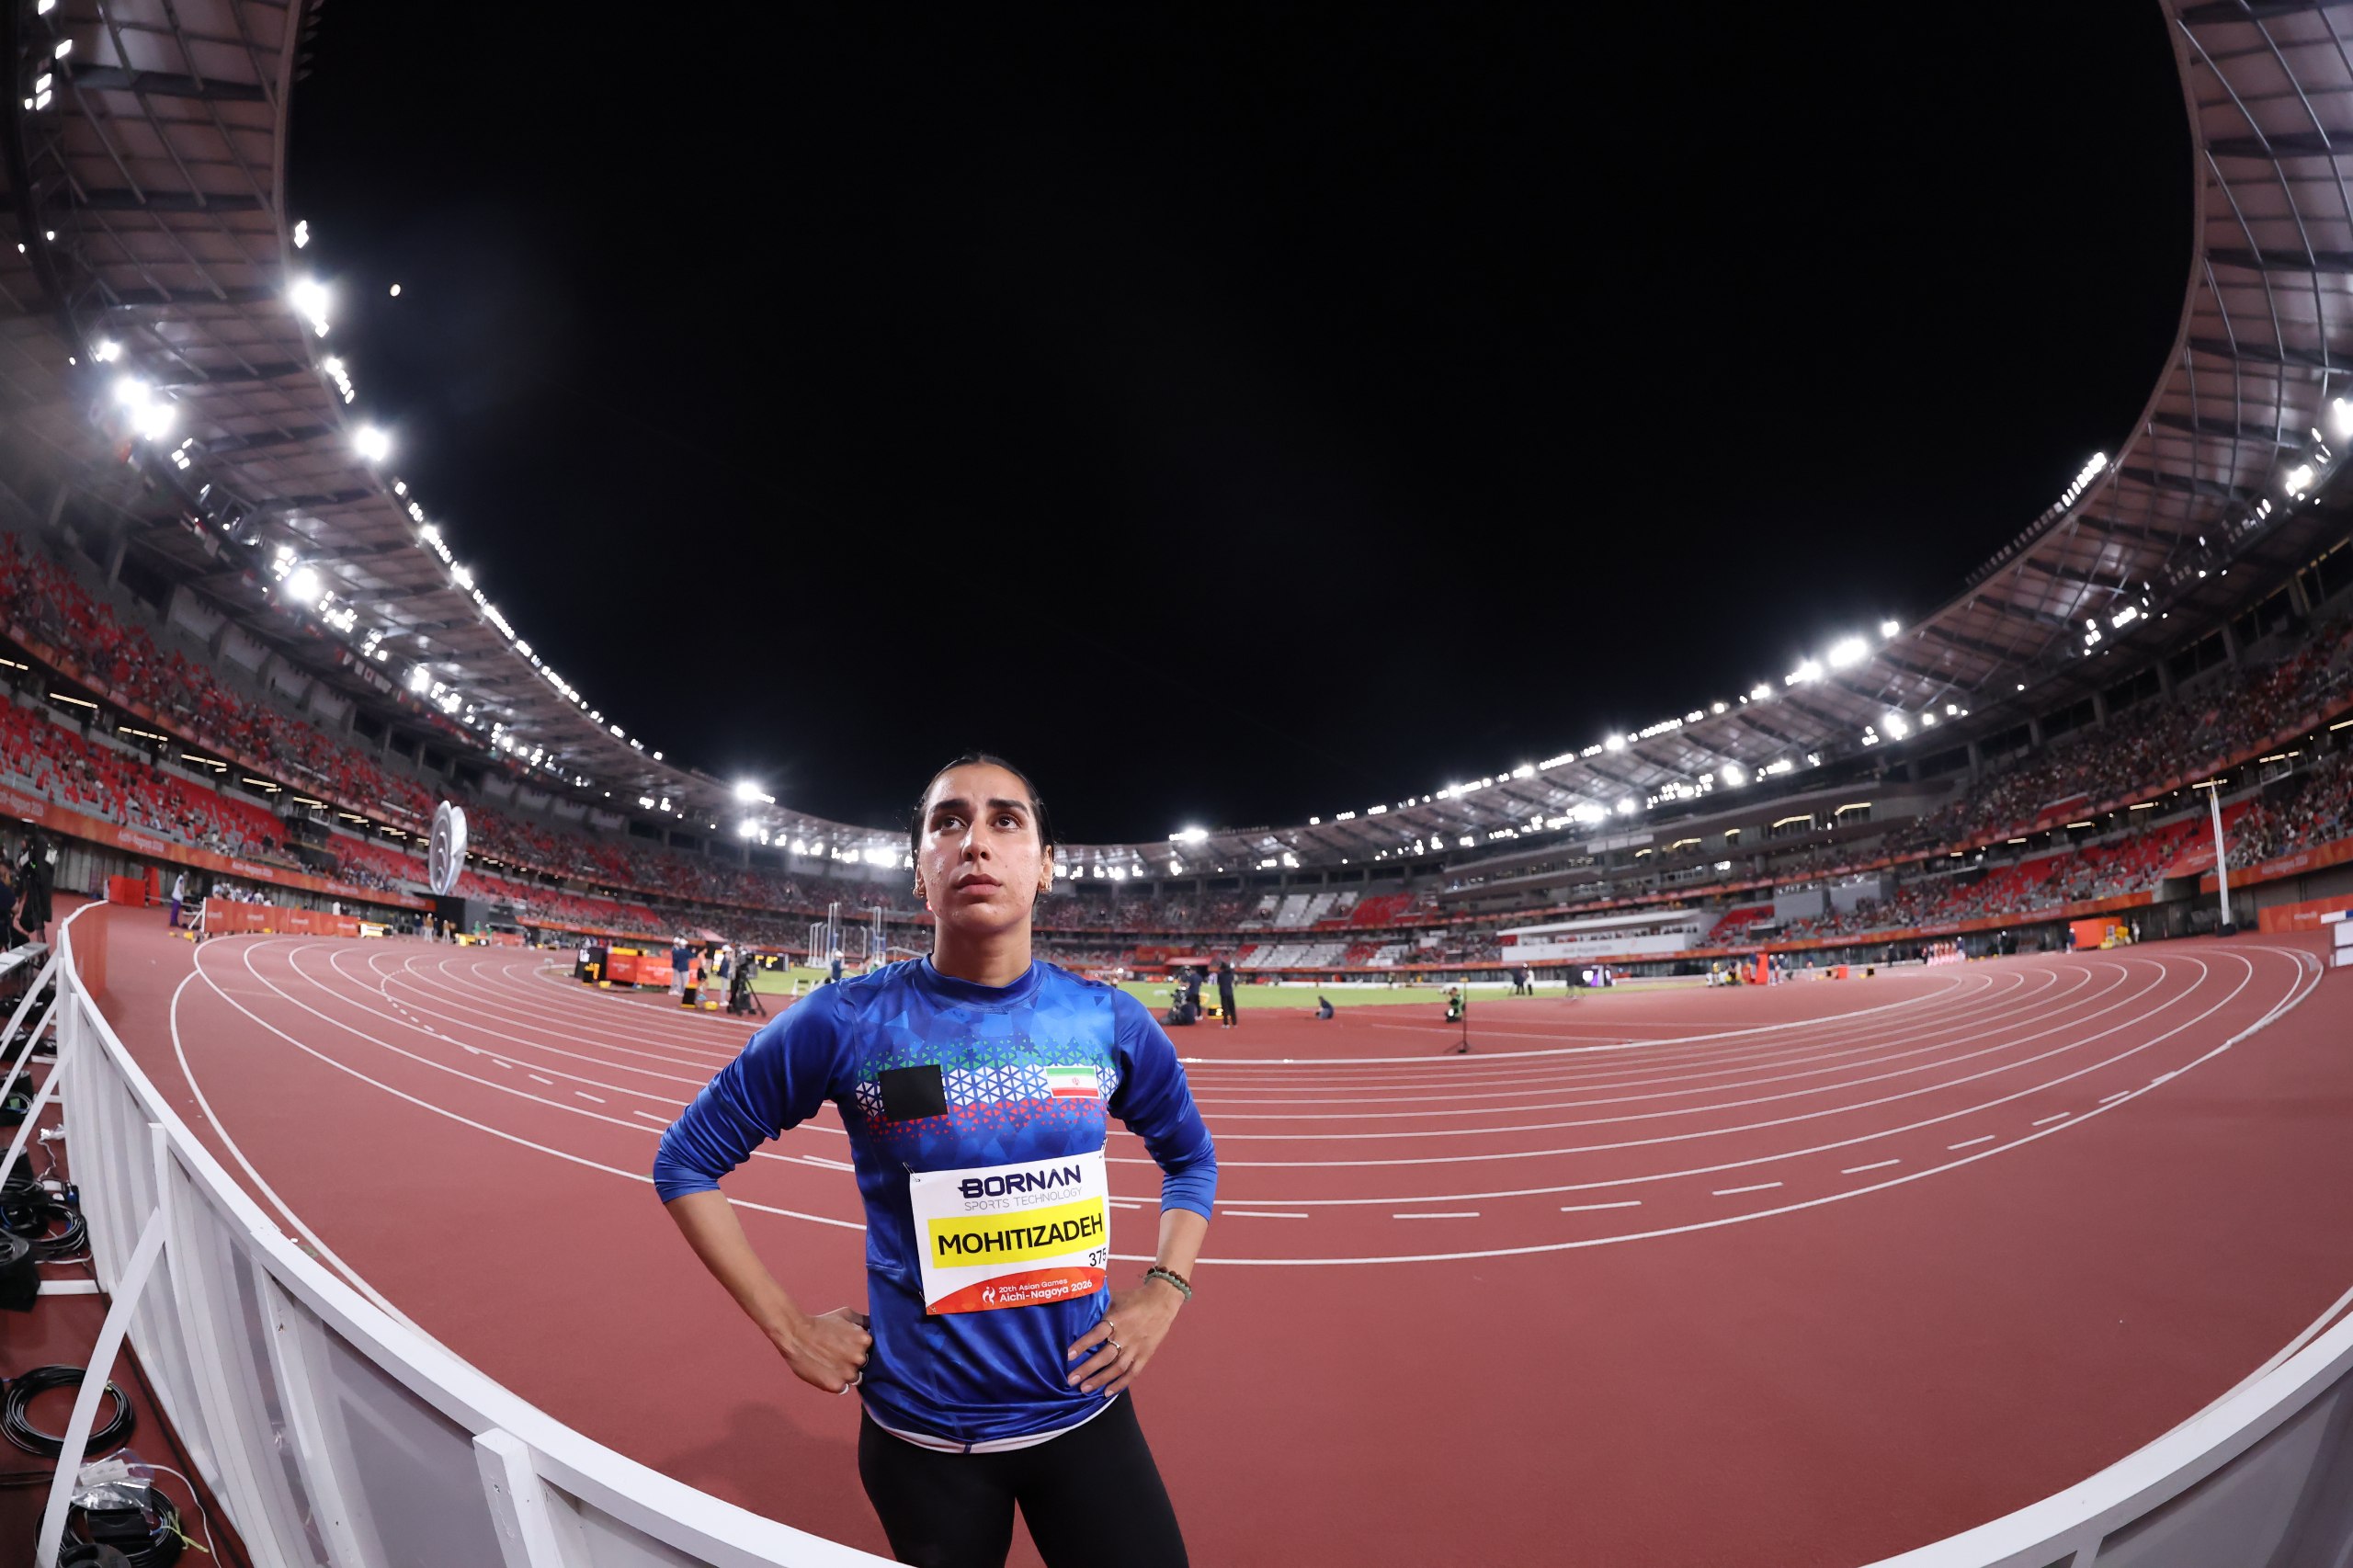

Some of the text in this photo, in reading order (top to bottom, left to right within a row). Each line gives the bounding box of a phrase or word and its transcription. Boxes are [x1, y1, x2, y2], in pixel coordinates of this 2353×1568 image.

[958, 1164, 1082, 1199] BORNAN
[964, 1187, 1083, 1211] SPORTS TECHNOLOGY
[938, 1212, 1103, 1256] MOHITIZADEH
[999, 1279, 1093, 1302] Aichi-Nagoya 2026
[1018, 1283, 1040, 1291] Asian
[1041, 1278, 1068, 1288] Games
